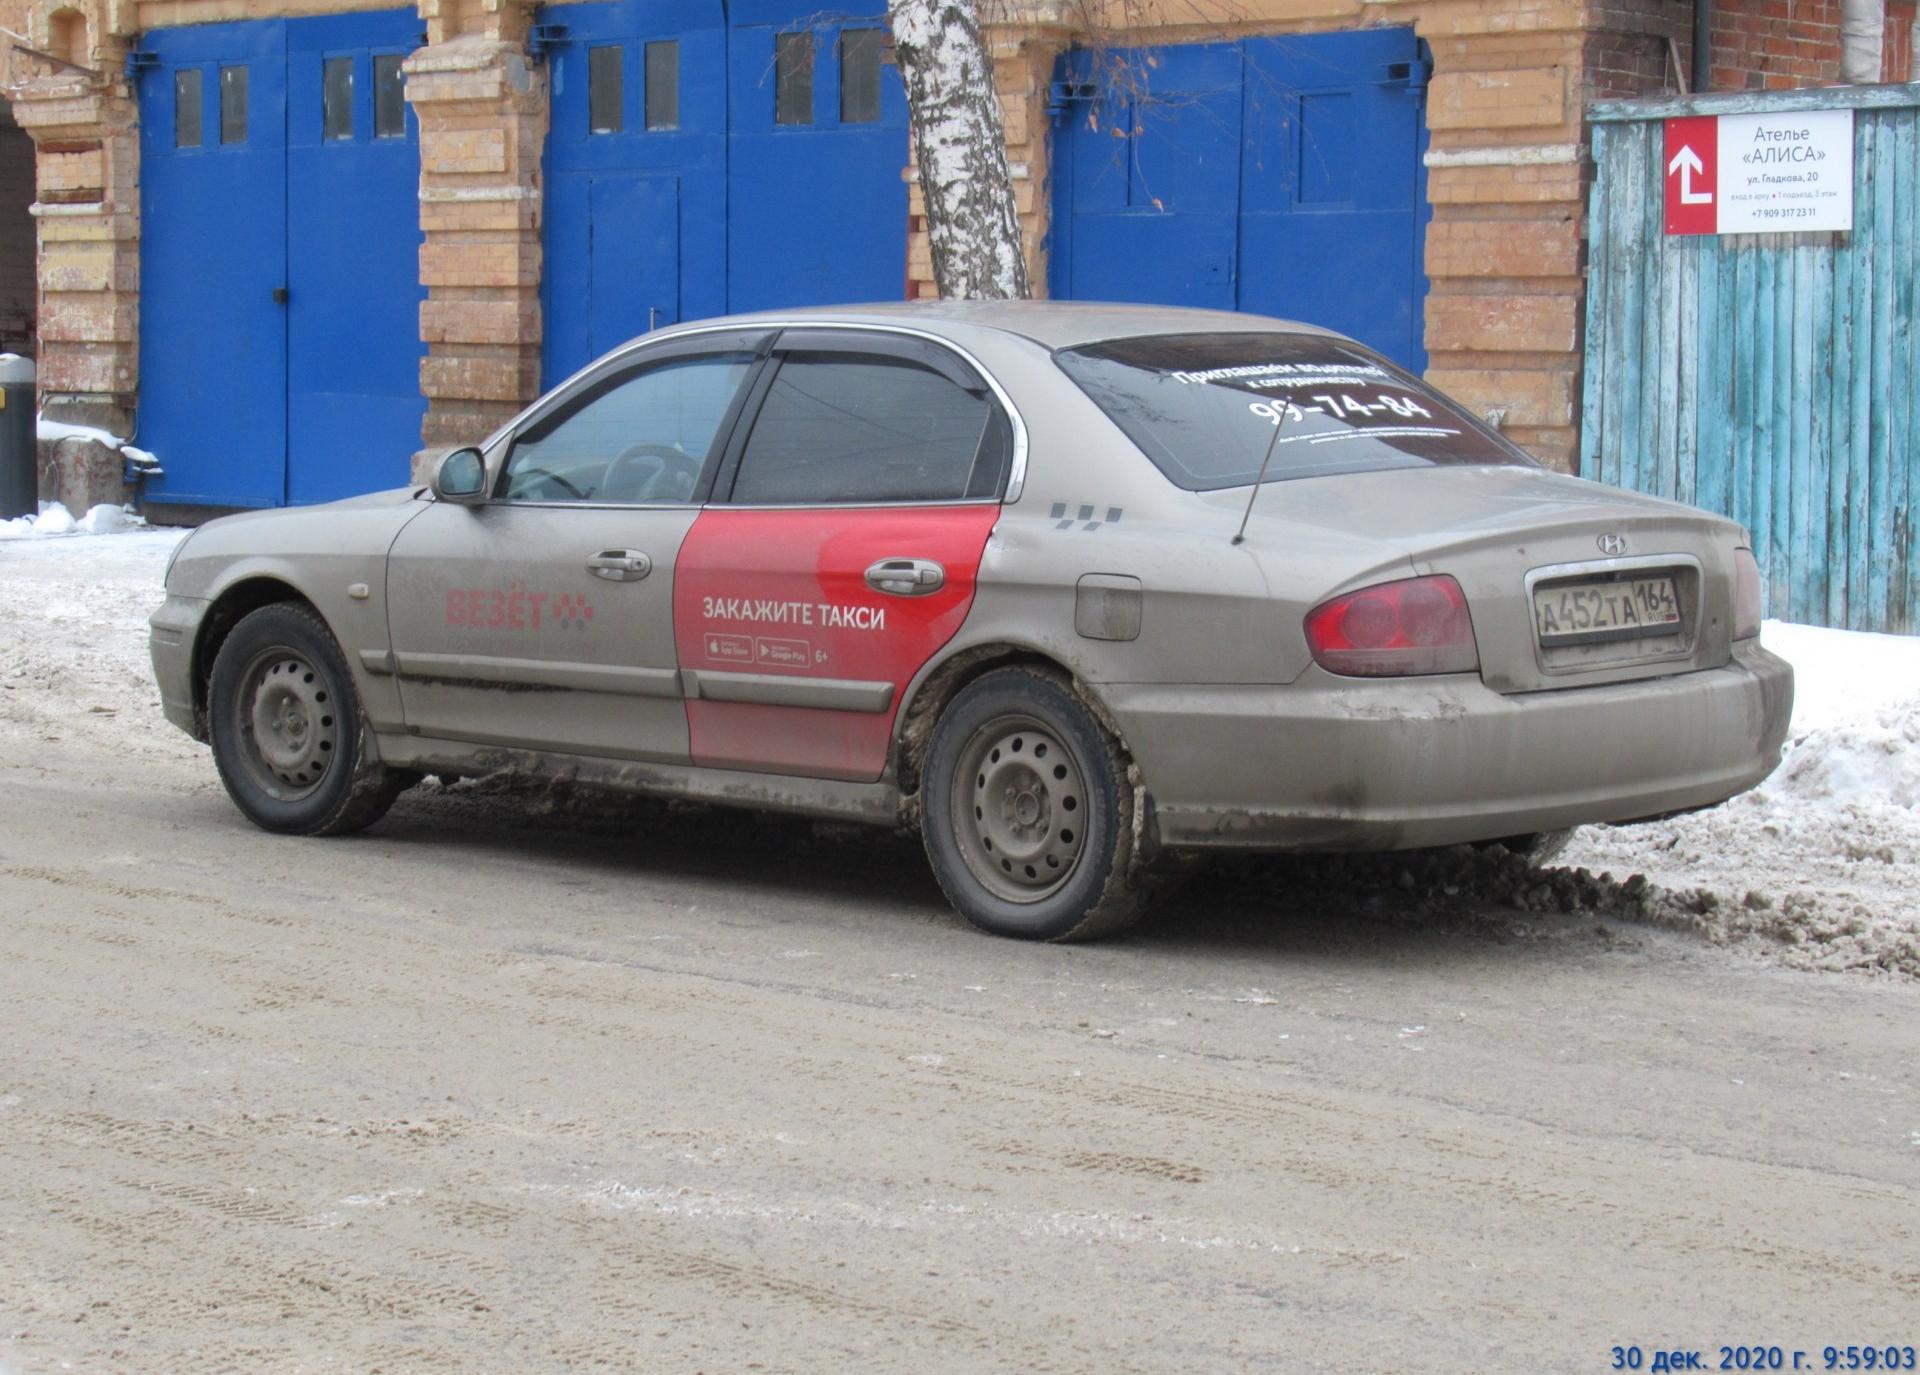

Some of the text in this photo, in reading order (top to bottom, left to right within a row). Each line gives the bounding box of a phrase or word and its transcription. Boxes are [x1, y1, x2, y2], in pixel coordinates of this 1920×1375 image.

[1754, 126, 1810, 142] Ателье
[1742, 146, 1826, 164] «АЛИСА»
[1747, 172, 1818, 186] ул. Гладкова, 20
[1752, 207, 1816, 218] +7 909 317 23 11
[1249, 394, 1432, 425] 99-74-84
[447, 580, 547, 631] ВЕЗЁТ
[703, 597, 885, 630] ЗАКАЖИТЕ ТАКСИ
[815, 650, 829, 663] 6+
